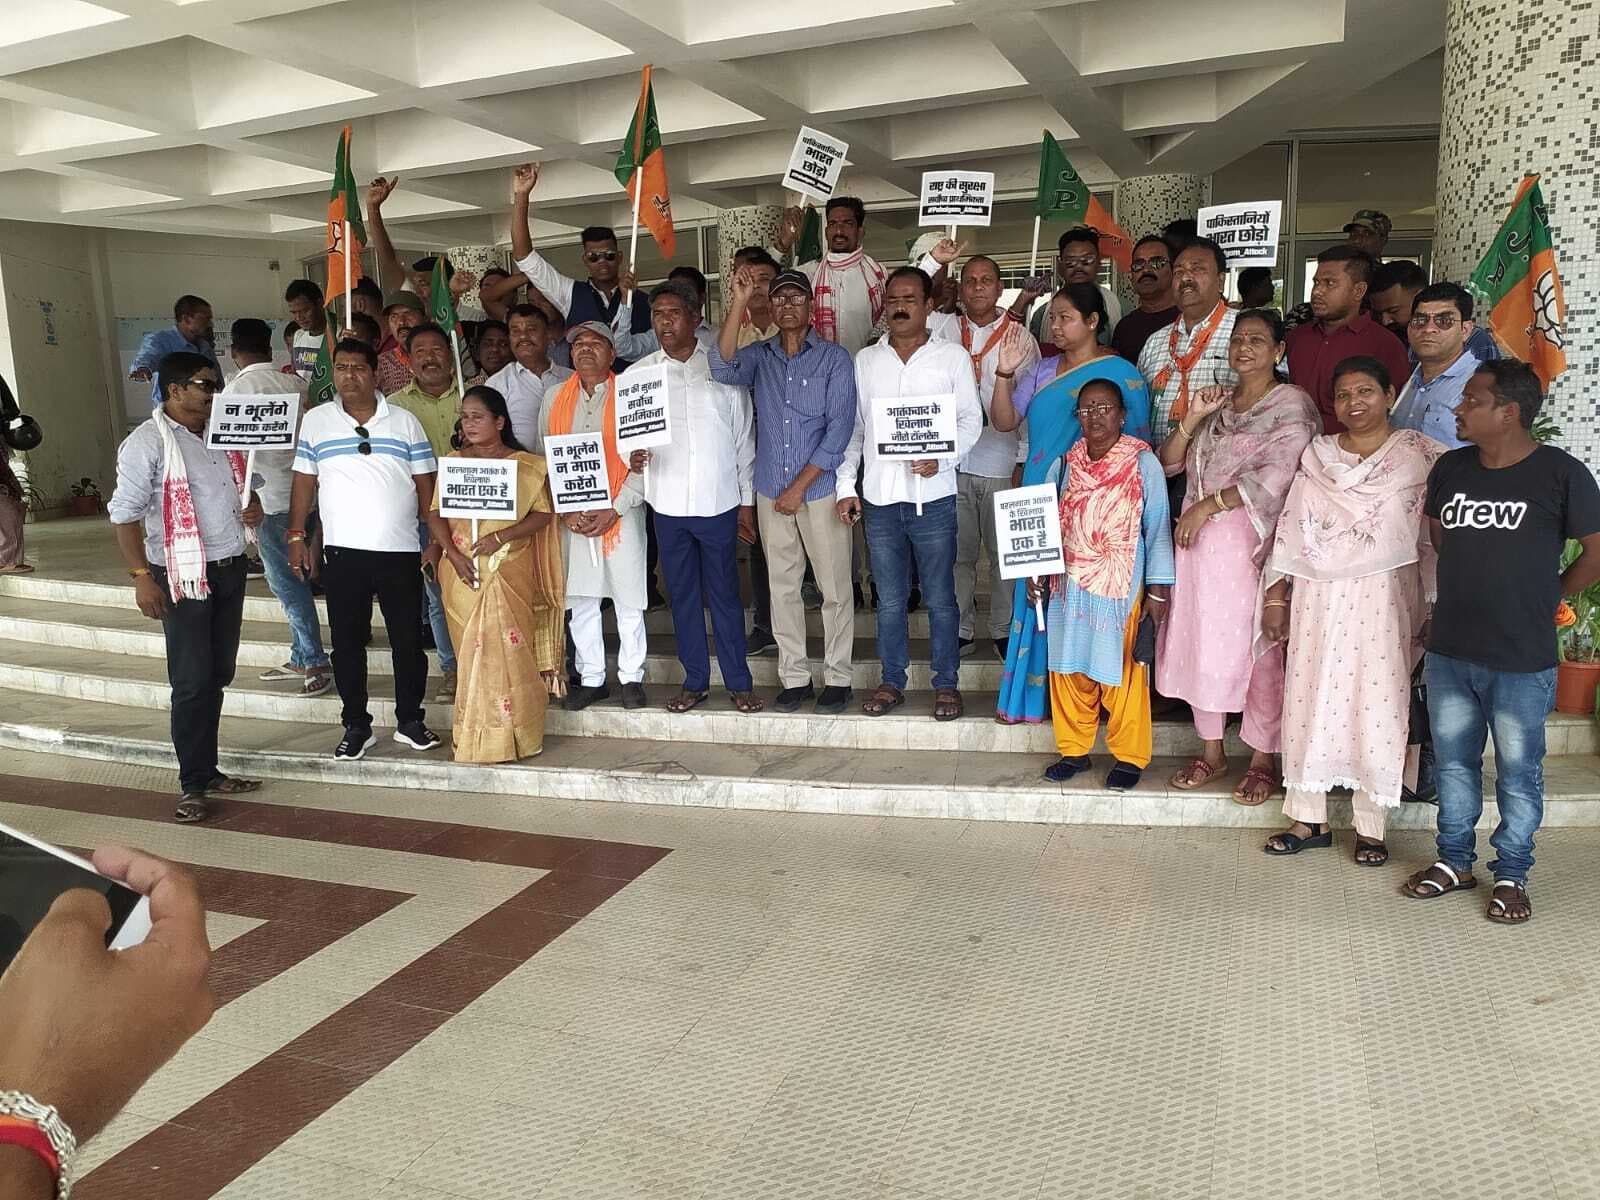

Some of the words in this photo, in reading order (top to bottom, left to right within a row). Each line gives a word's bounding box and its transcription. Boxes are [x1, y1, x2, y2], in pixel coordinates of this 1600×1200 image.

[805, 146, 834, 166] भारत
[945, 178, 957, 190] की
[958, 181, 987, 194] सुरक्षा
[1206, 210, 1271, 229] पाकिस्तानियों
[1238, 225, 1269, 245] छोड़ो
[631, 383, 640, 393] की
[224, 404, 241, 416] न
[245, 401, 289, 422] भूलेंगे
[619, 406, 664, 425] प्राथमिकता
[886, 403, 930, 417] आतंकवाद
[930, 402, 941, 415] के
[219, 422, 231, 432] न
[233, 423, 259, 432] माफ
[262, 420, 288, 431] करेंगे
[895, 417, 933, 429] खिलाफ
[891, 430, 909, 441] जीरो
[552, 447, 564, 457] न
[566, 441, 599, 460] भूलेंगे
[500, 466, 508, 475] के
[555, 462, 568, 474] न
[570, 459, 601, 473] माफ
[447, 483, 476, 496] भारत
[477, 484, 498, 496] एक
[563, 474, 597, 491] करेंगे
[1009, 510, 1016, 518] के
[1441, 493, 1527, 530] drew
[1009, 516, 1046, 531] भारत
[1010, 536, 1034, 551] एक
[1036, 530, 1047, 547] है
